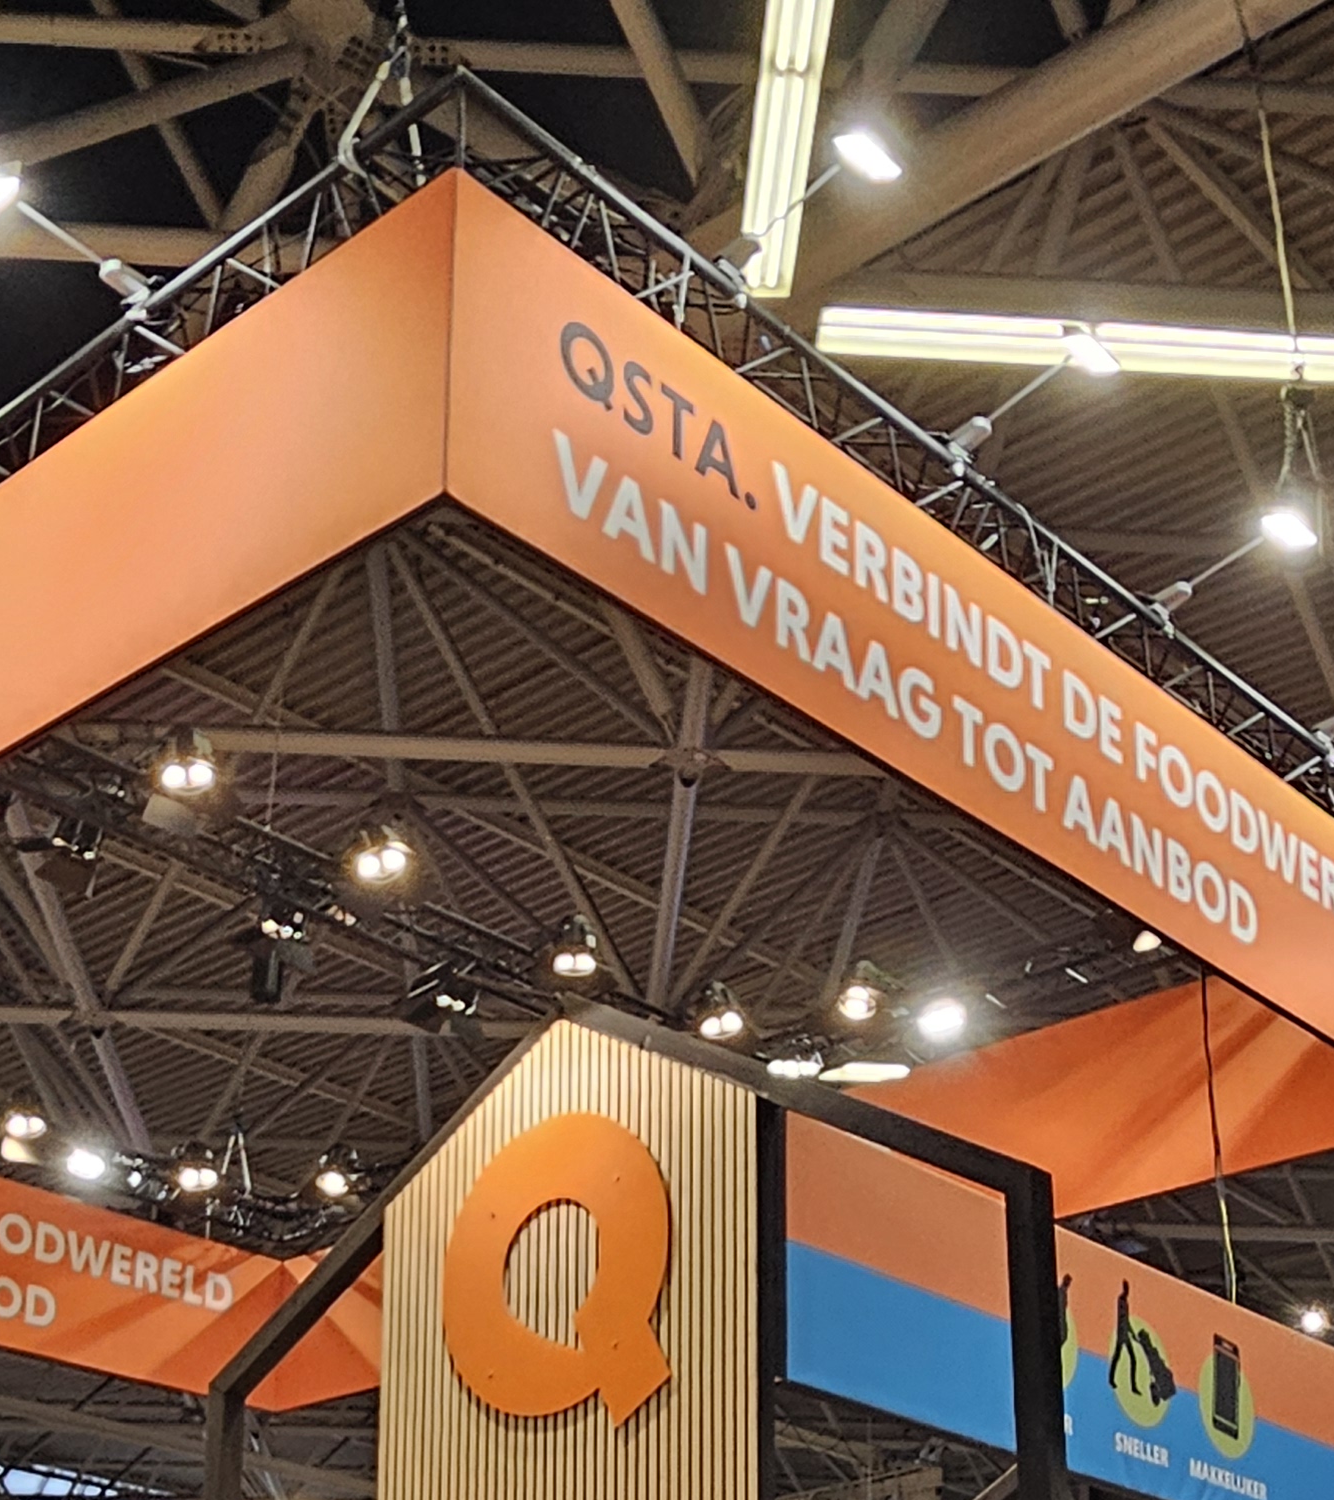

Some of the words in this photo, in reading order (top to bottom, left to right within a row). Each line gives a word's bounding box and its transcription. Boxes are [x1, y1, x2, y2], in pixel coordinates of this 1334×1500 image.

[552, 427, 708, 596] VAN
[724, 542, 942, 740] VRAAG
[951, 694, 1054, 813] TOT
[1062, 774, 1259, 945] AANBOD
[560, 321, 757, 510] QSTA.
[771, 459, 1052, 710] VERBINDT
[1062, 669, 1123, 764] DE
[442, 1110, 671, 1428] Q
[1115, 1432, 1169, 1468] SNELLER
